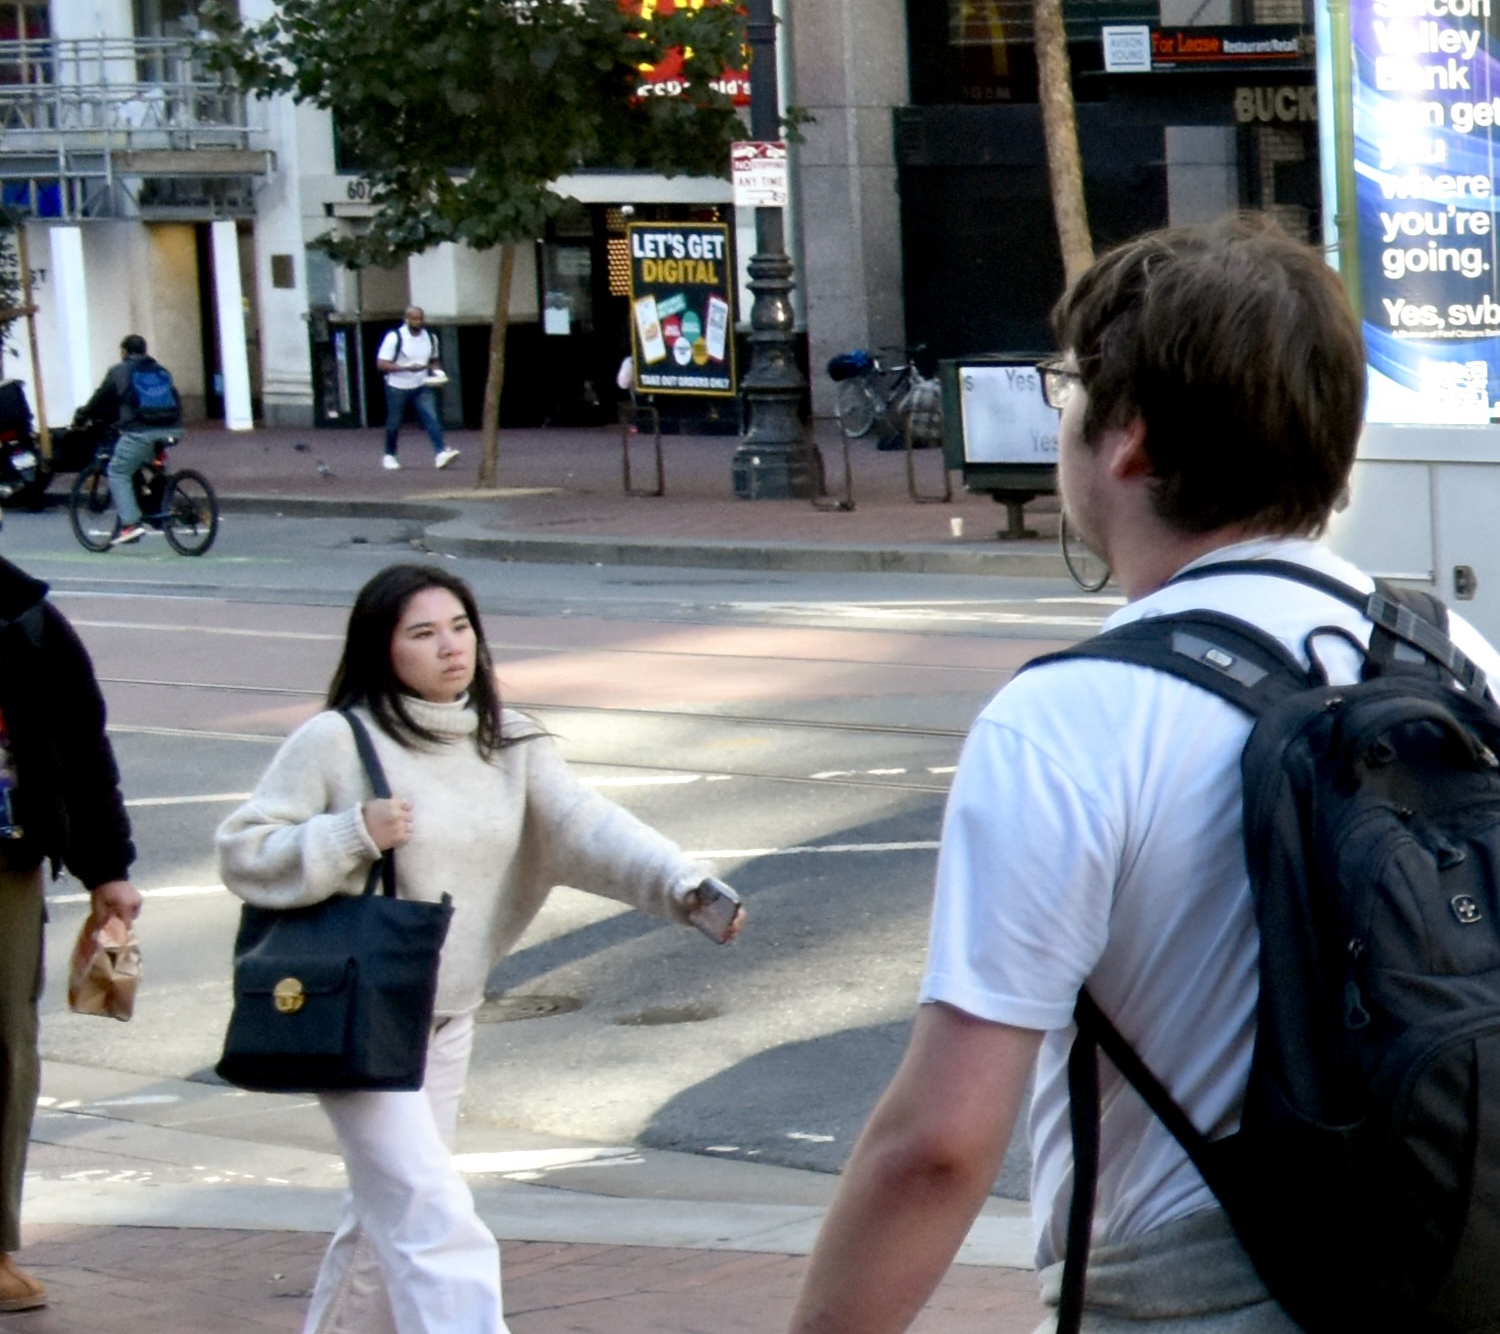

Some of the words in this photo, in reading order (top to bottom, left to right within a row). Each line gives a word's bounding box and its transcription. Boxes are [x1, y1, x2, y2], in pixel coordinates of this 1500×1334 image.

[1152, 31, 1174, 53] For
[1177, 31, 1221, 53] Lease
[1373, 20, 1481, 60] Vlley
[1375, 57, 1471, 91] Bnk
[735, 160, 751, 170] NO
[1378, 138, 1447, 171] yu
[739, 176, 757, 186] ANY
[761, 176, 783, 186] TIME
[1380, 167, 1491, 200] where
[632, 232, 685, 259] LET'S
[687, 234, 725, 260] GET
[1381, 240, 1491, 280] going.
[641, 259, 719, 284] DIGITAL
[1382, 298, 1446, 329] Yes,
[709, 377, 730, 389] ONLY
[1005, 369, 1036, 391] Yes
